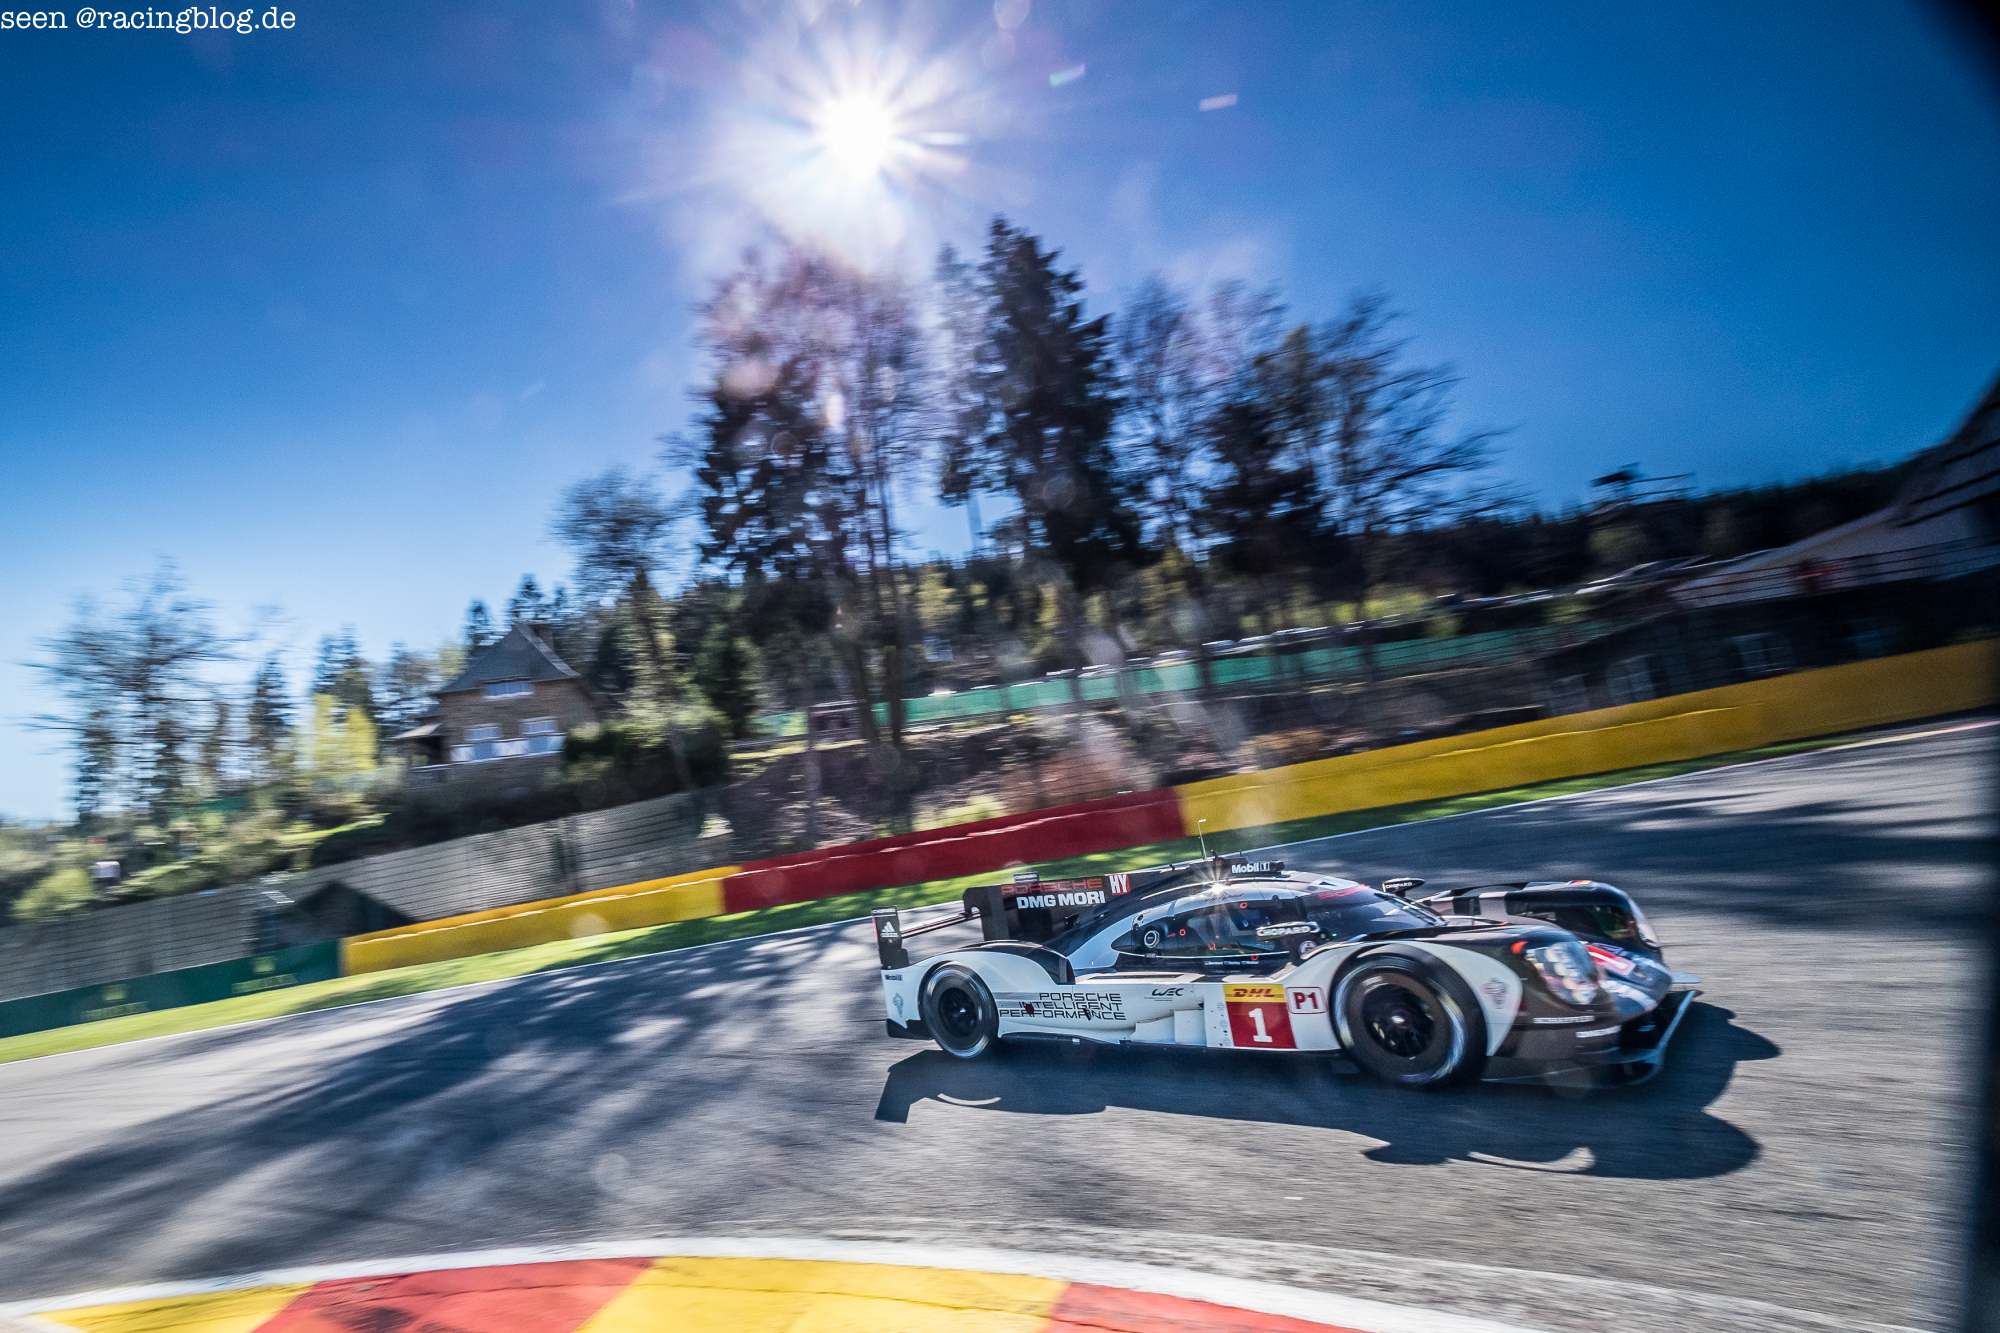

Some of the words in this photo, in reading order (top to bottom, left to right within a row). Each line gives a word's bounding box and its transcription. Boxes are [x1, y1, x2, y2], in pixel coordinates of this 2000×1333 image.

[1001, 878, 1103, 895] PORSCHE
[1109, 874, 1128, 894] HY
[1017, 894, 1056, 909] DMG
[1058, 891, 1106, 907] MORI
[1040, 992, 1121, 1002] PORSCHE
[1232, 988, 1275, 997] DHL
[1293, 992, 1319, 1009] P1
[1248, 1008, 1272, 1042] 1
